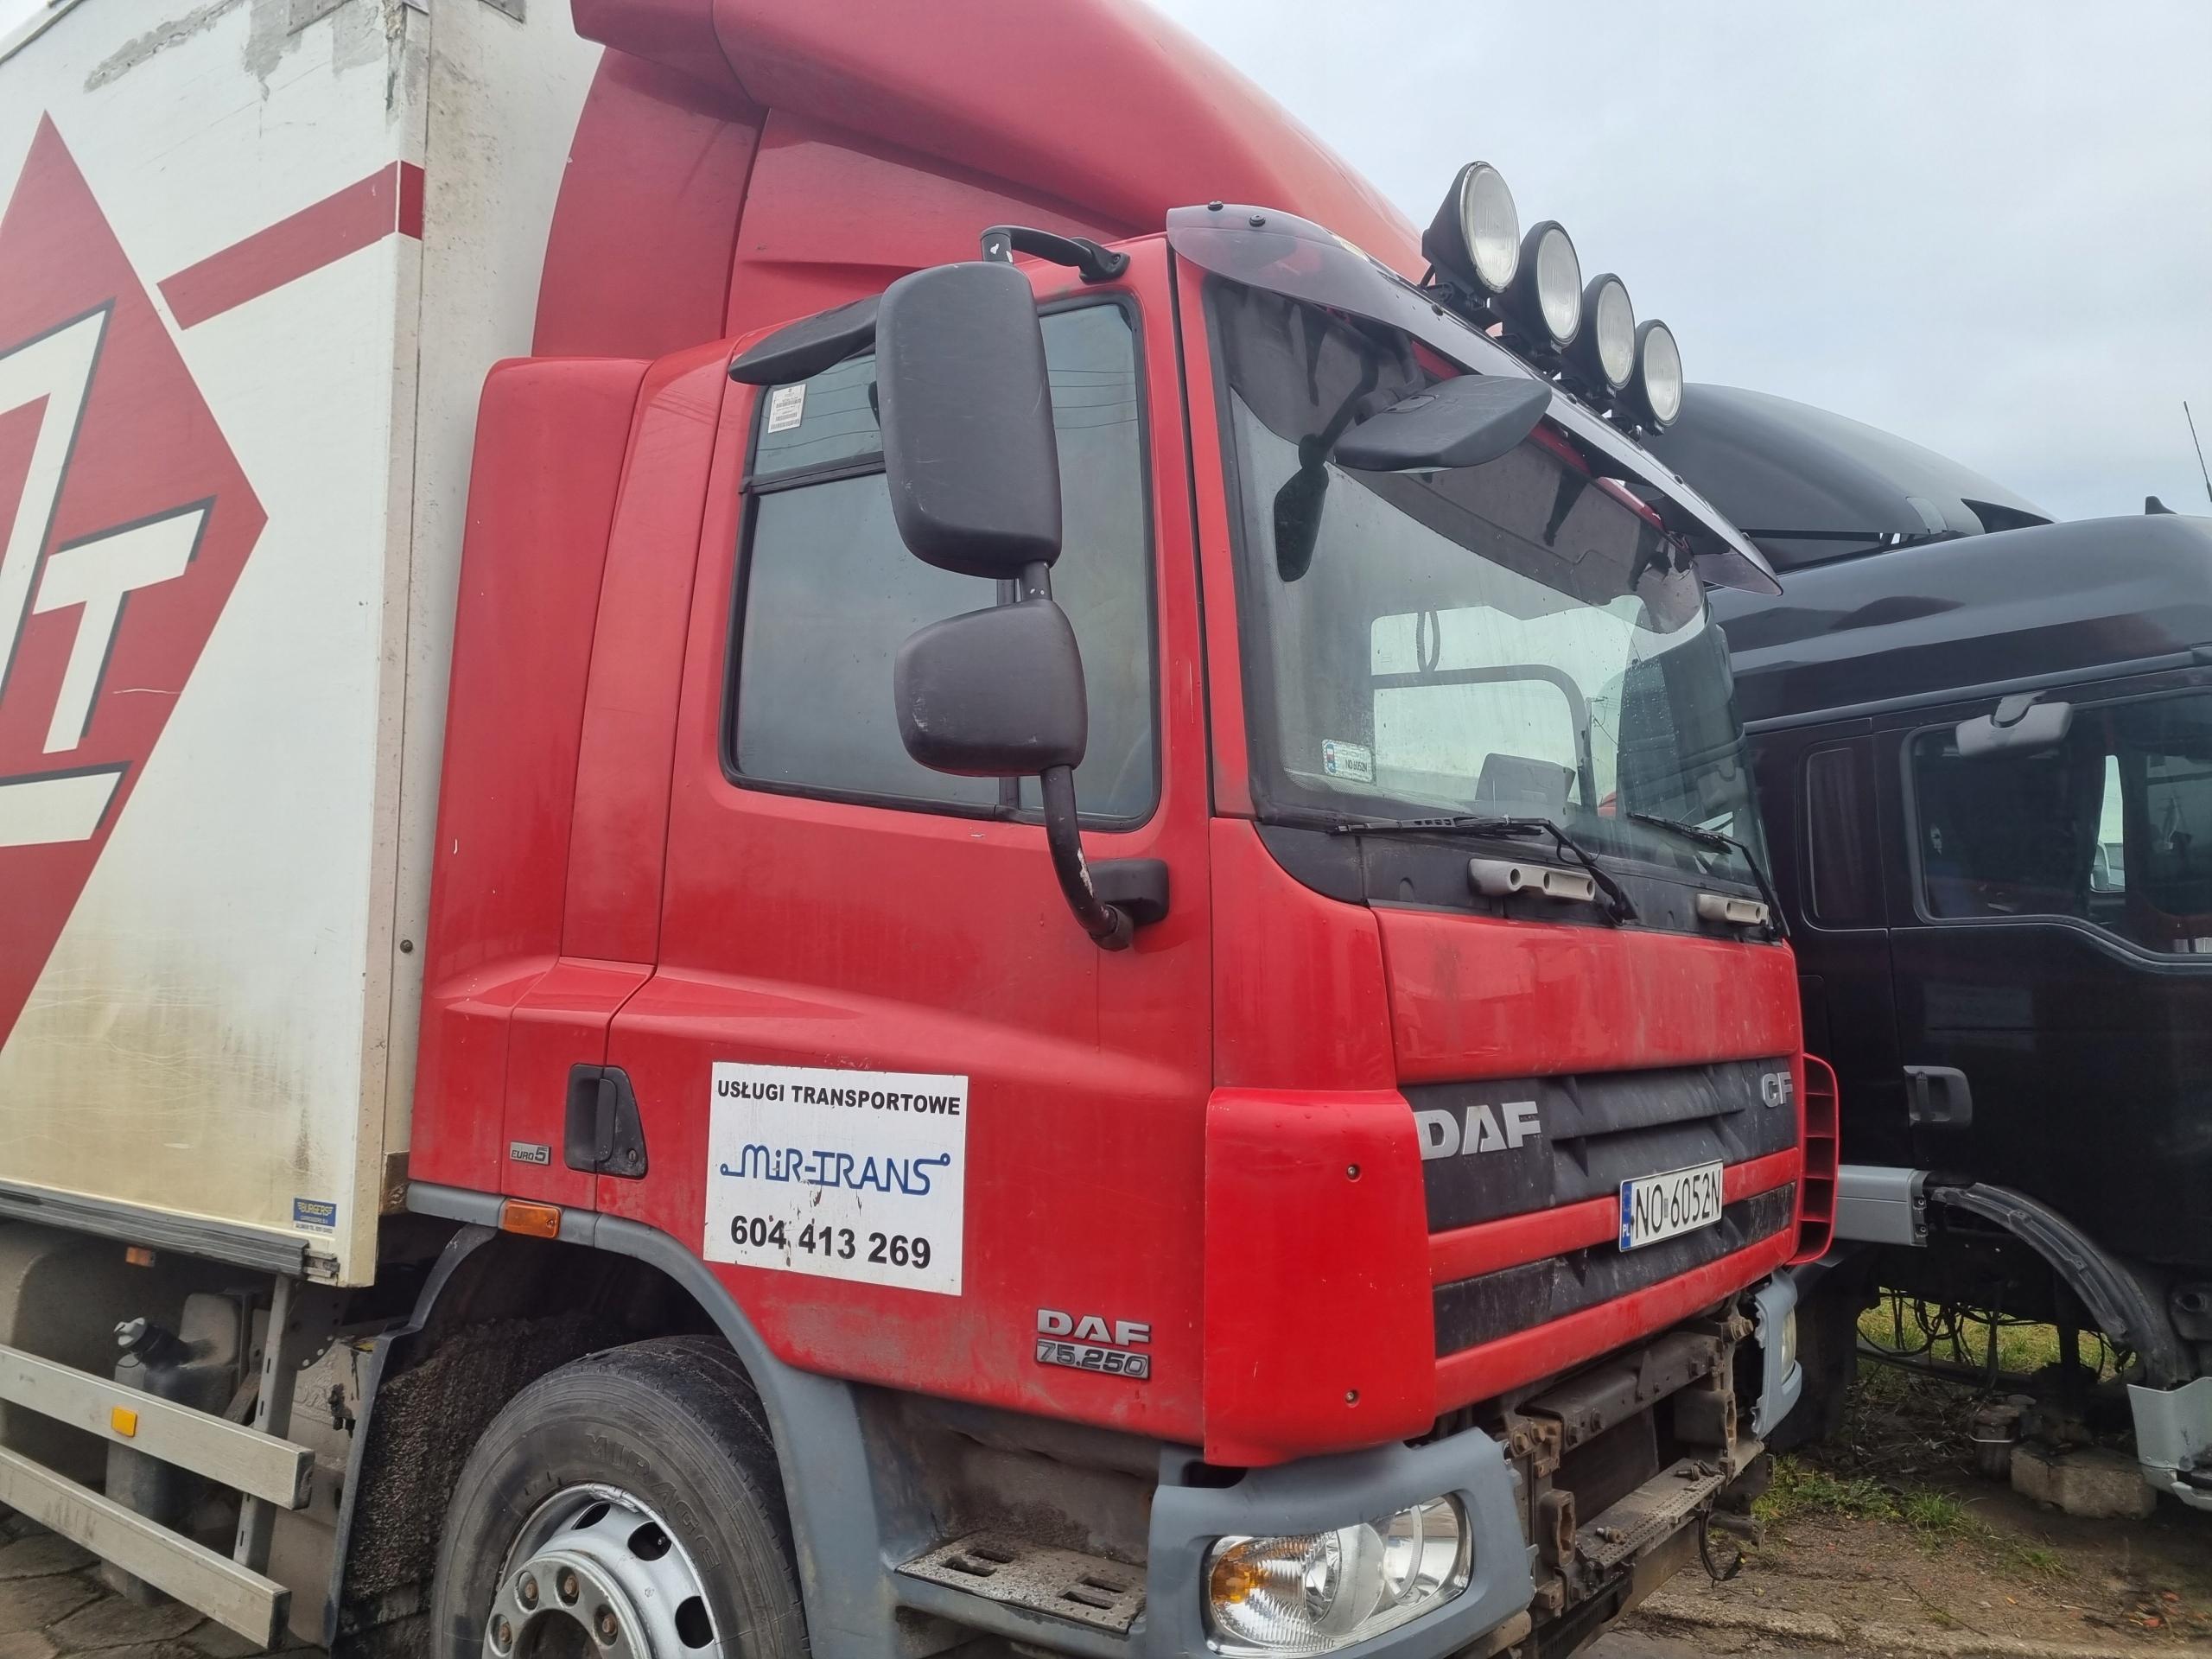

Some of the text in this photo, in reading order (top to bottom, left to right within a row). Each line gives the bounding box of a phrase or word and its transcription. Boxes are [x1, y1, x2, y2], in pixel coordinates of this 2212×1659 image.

[717, 1079, 961, 1116] USŁUGI TRANSPORTOWE
[1762, 1071, 1793, 1108] CF
[1413, 1101, 1541, 1161] DAF
[1635, 1169, 1721, 1240] NO 6052N
[730, 1215, 931, 1270] 604 413 269
[1622, 1223, 1631, 1238] PL
[1037, 1309, 1149, 1346] DAF
[1038, 1340, 1147, 1376] 75.250
[585, 1432, 721, 1573] MIRAGE
